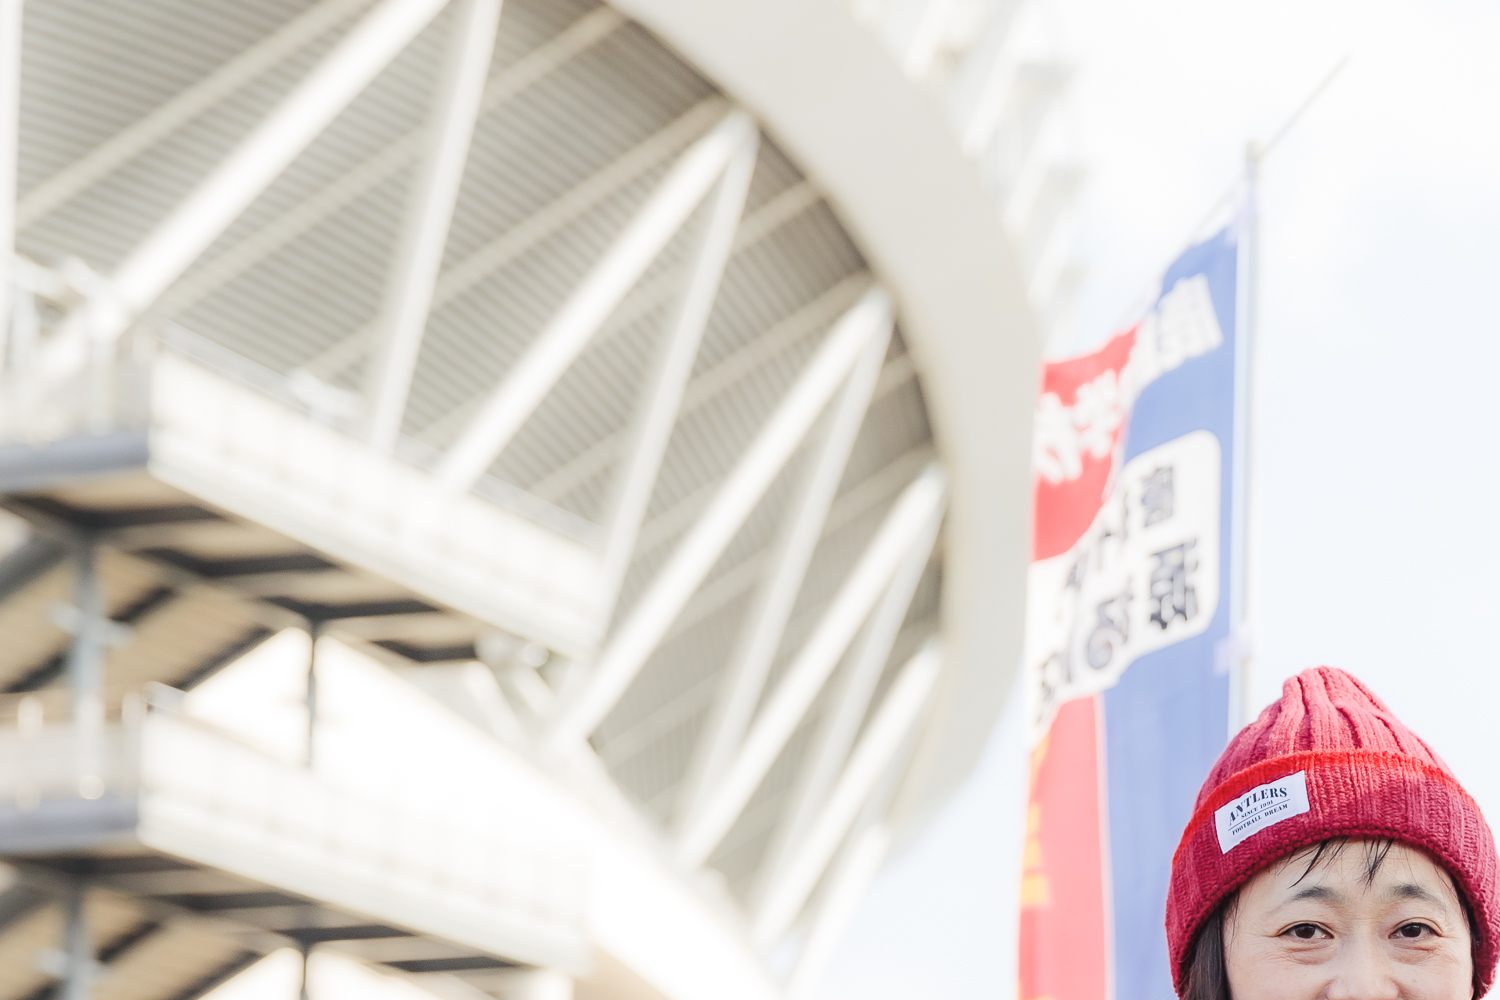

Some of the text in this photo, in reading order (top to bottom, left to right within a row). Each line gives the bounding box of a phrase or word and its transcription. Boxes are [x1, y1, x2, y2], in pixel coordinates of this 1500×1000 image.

[1229, 787, 1287, 826] ANTLERS
[1232, 803, 1288, 836] FOOTBALL DREAM
[1241, 807, 1258, 819] SINCE
